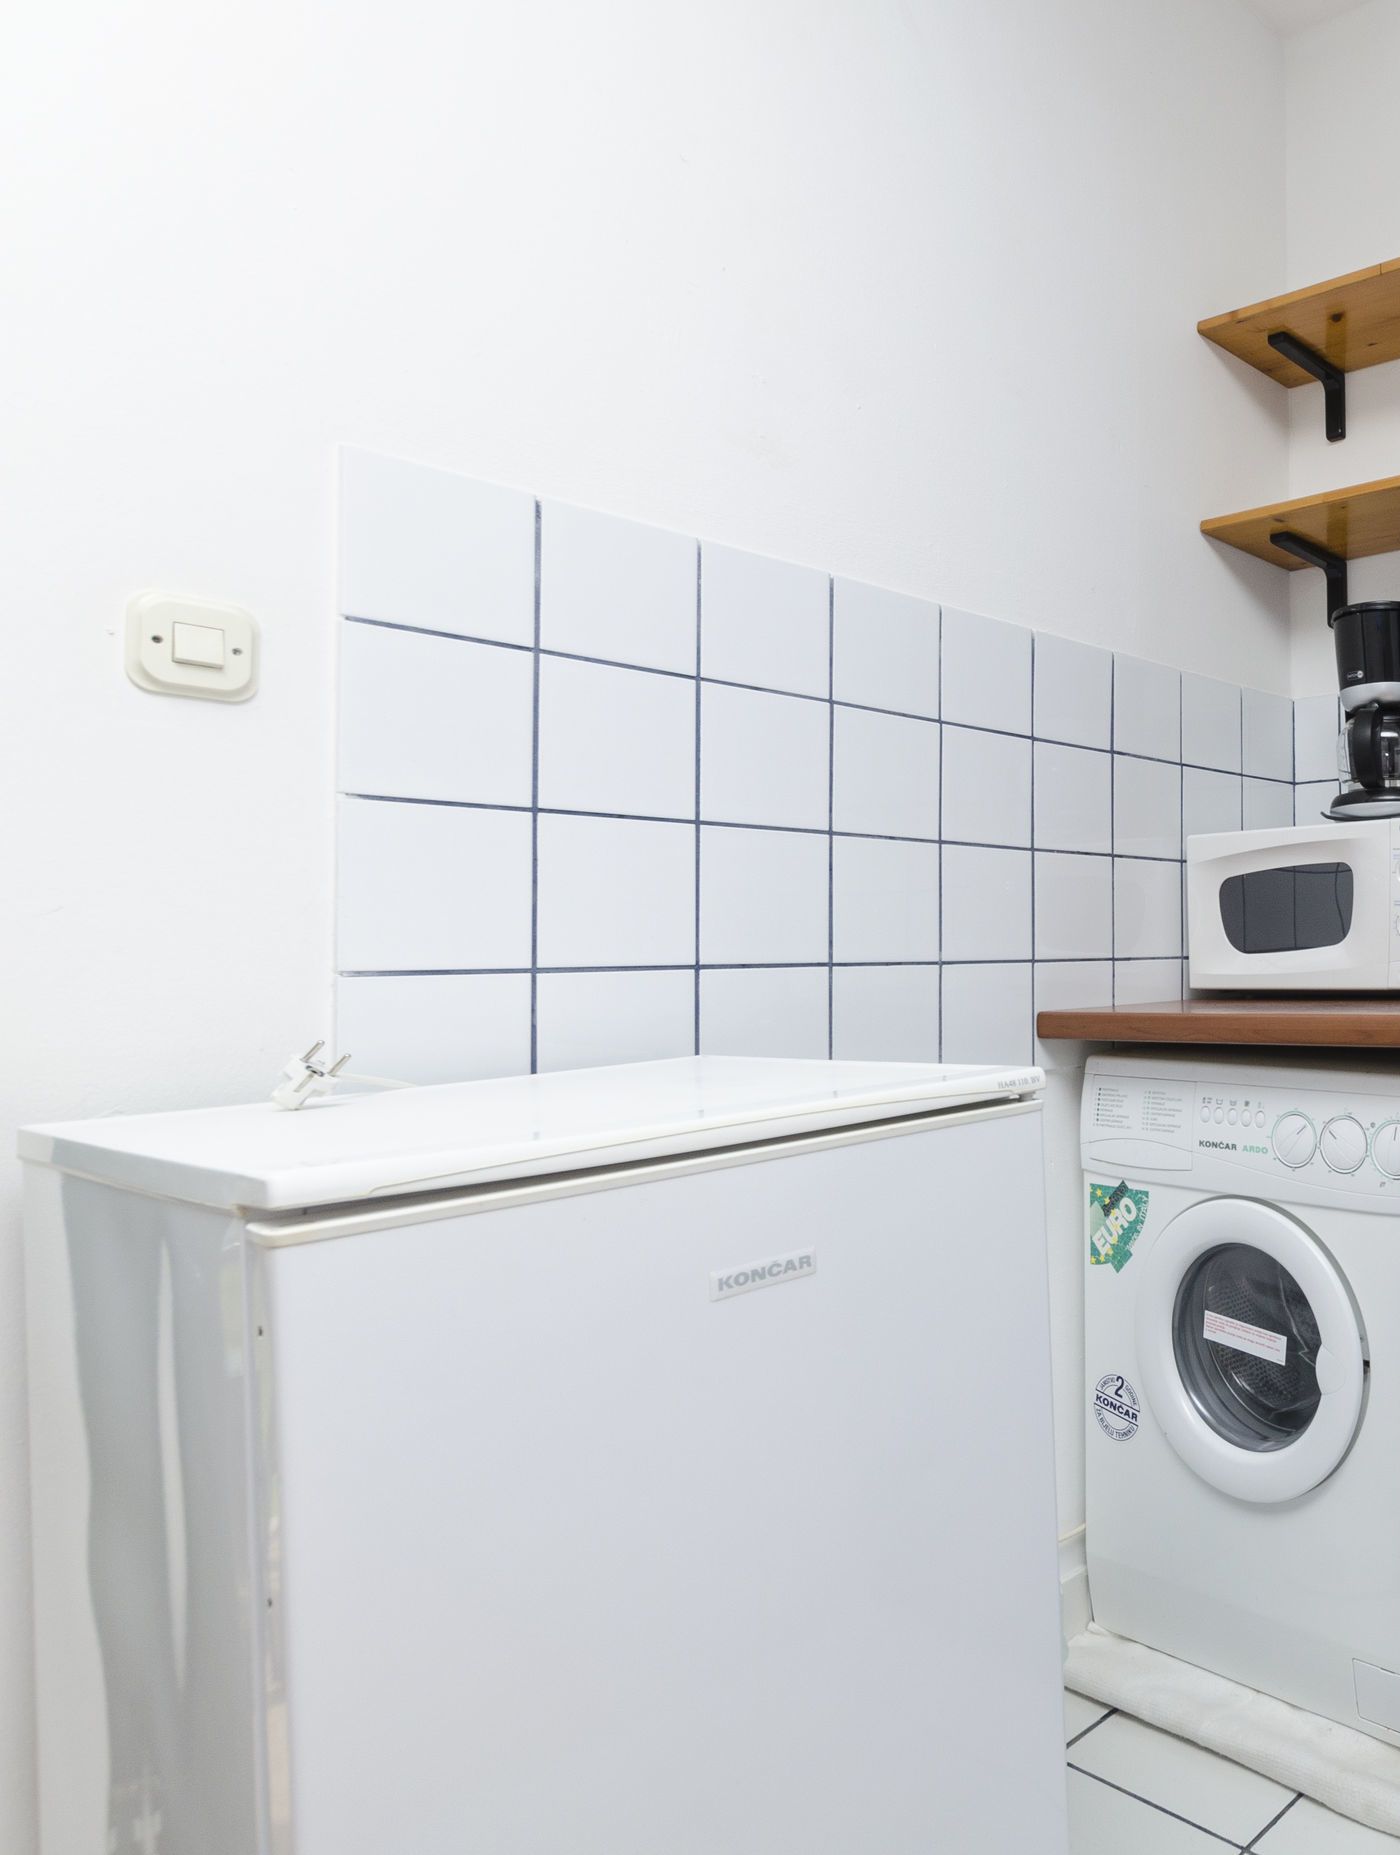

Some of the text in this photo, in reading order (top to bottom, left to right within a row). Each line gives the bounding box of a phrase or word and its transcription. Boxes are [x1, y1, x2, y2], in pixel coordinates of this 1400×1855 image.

[1198, 1140, 1269, 1154] KONČAR ARDO
[1092, 1197, 1137, 1255] EURO
[717, 1254, 813, 1292] KONČAR
[1114, 1375, 1124, 1398] 2
[1095, 1393, 1138, 1422] KONČAR
